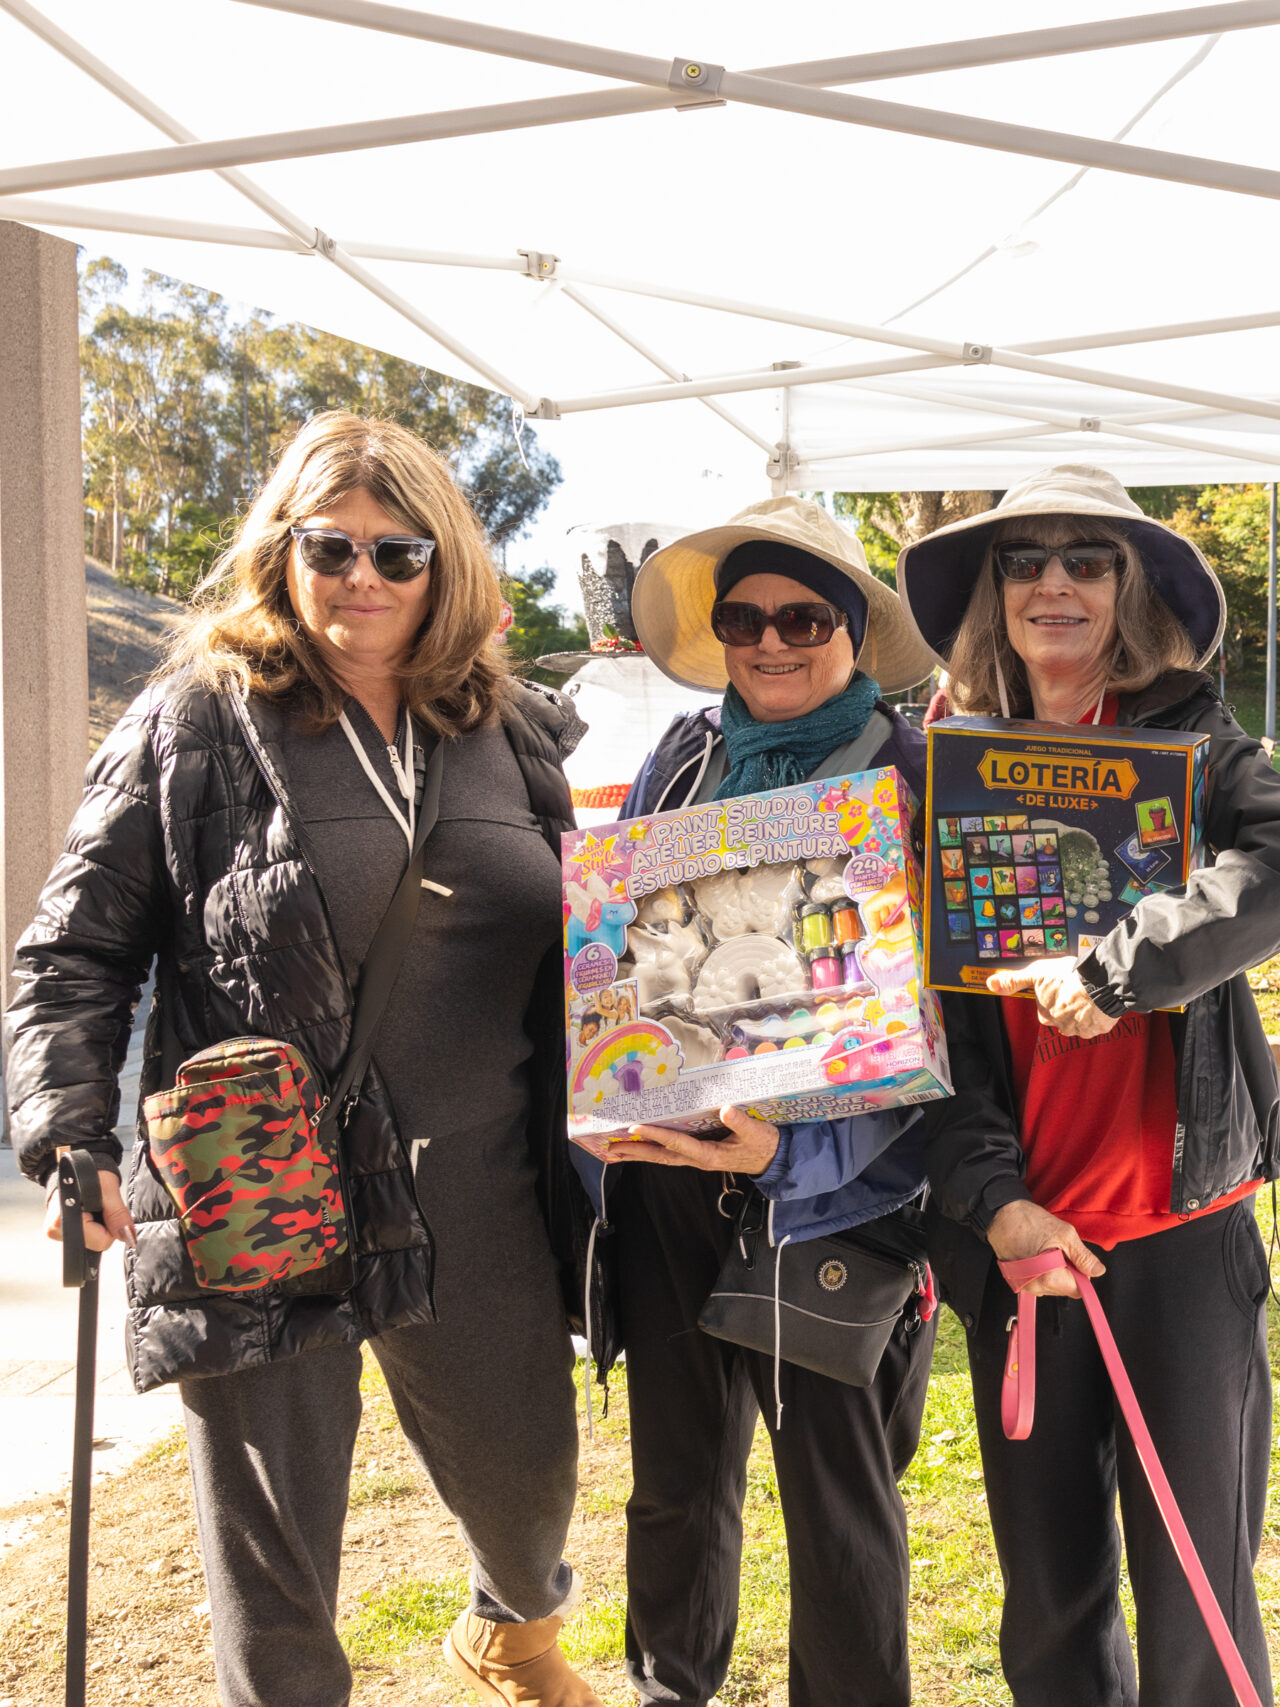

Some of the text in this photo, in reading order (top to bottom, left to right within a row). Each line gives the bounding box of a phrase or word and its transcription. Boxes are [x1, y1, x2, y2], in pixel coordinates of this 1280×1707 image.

[1024, 745, 1093, 756] JUEGO TRADICIONAL
[990, 760, 1123, 793] LOTERÍA
[1026, 794, 1089, 811] DE LUXE
[652, 796, 813, 847] PAINT STUDIO
[579, 838, 604, 857] Just
[631, 813, 839, 874] ATELIER PEINTURE
[581, 850, 617, 876] Style
[626, 835, 850, 898] ESTUDIO DE PINTURA
[852, 857, 878, 876] 24
[585, 946, 601, 962] 6
[887, 1056, 921, 1068] HORIZON
[755, 1095, 835, 1112] STUDIO
[762, 1096, 865, 1118] PEINTURE
[789, 1102, 880, 1120] PINTURA
